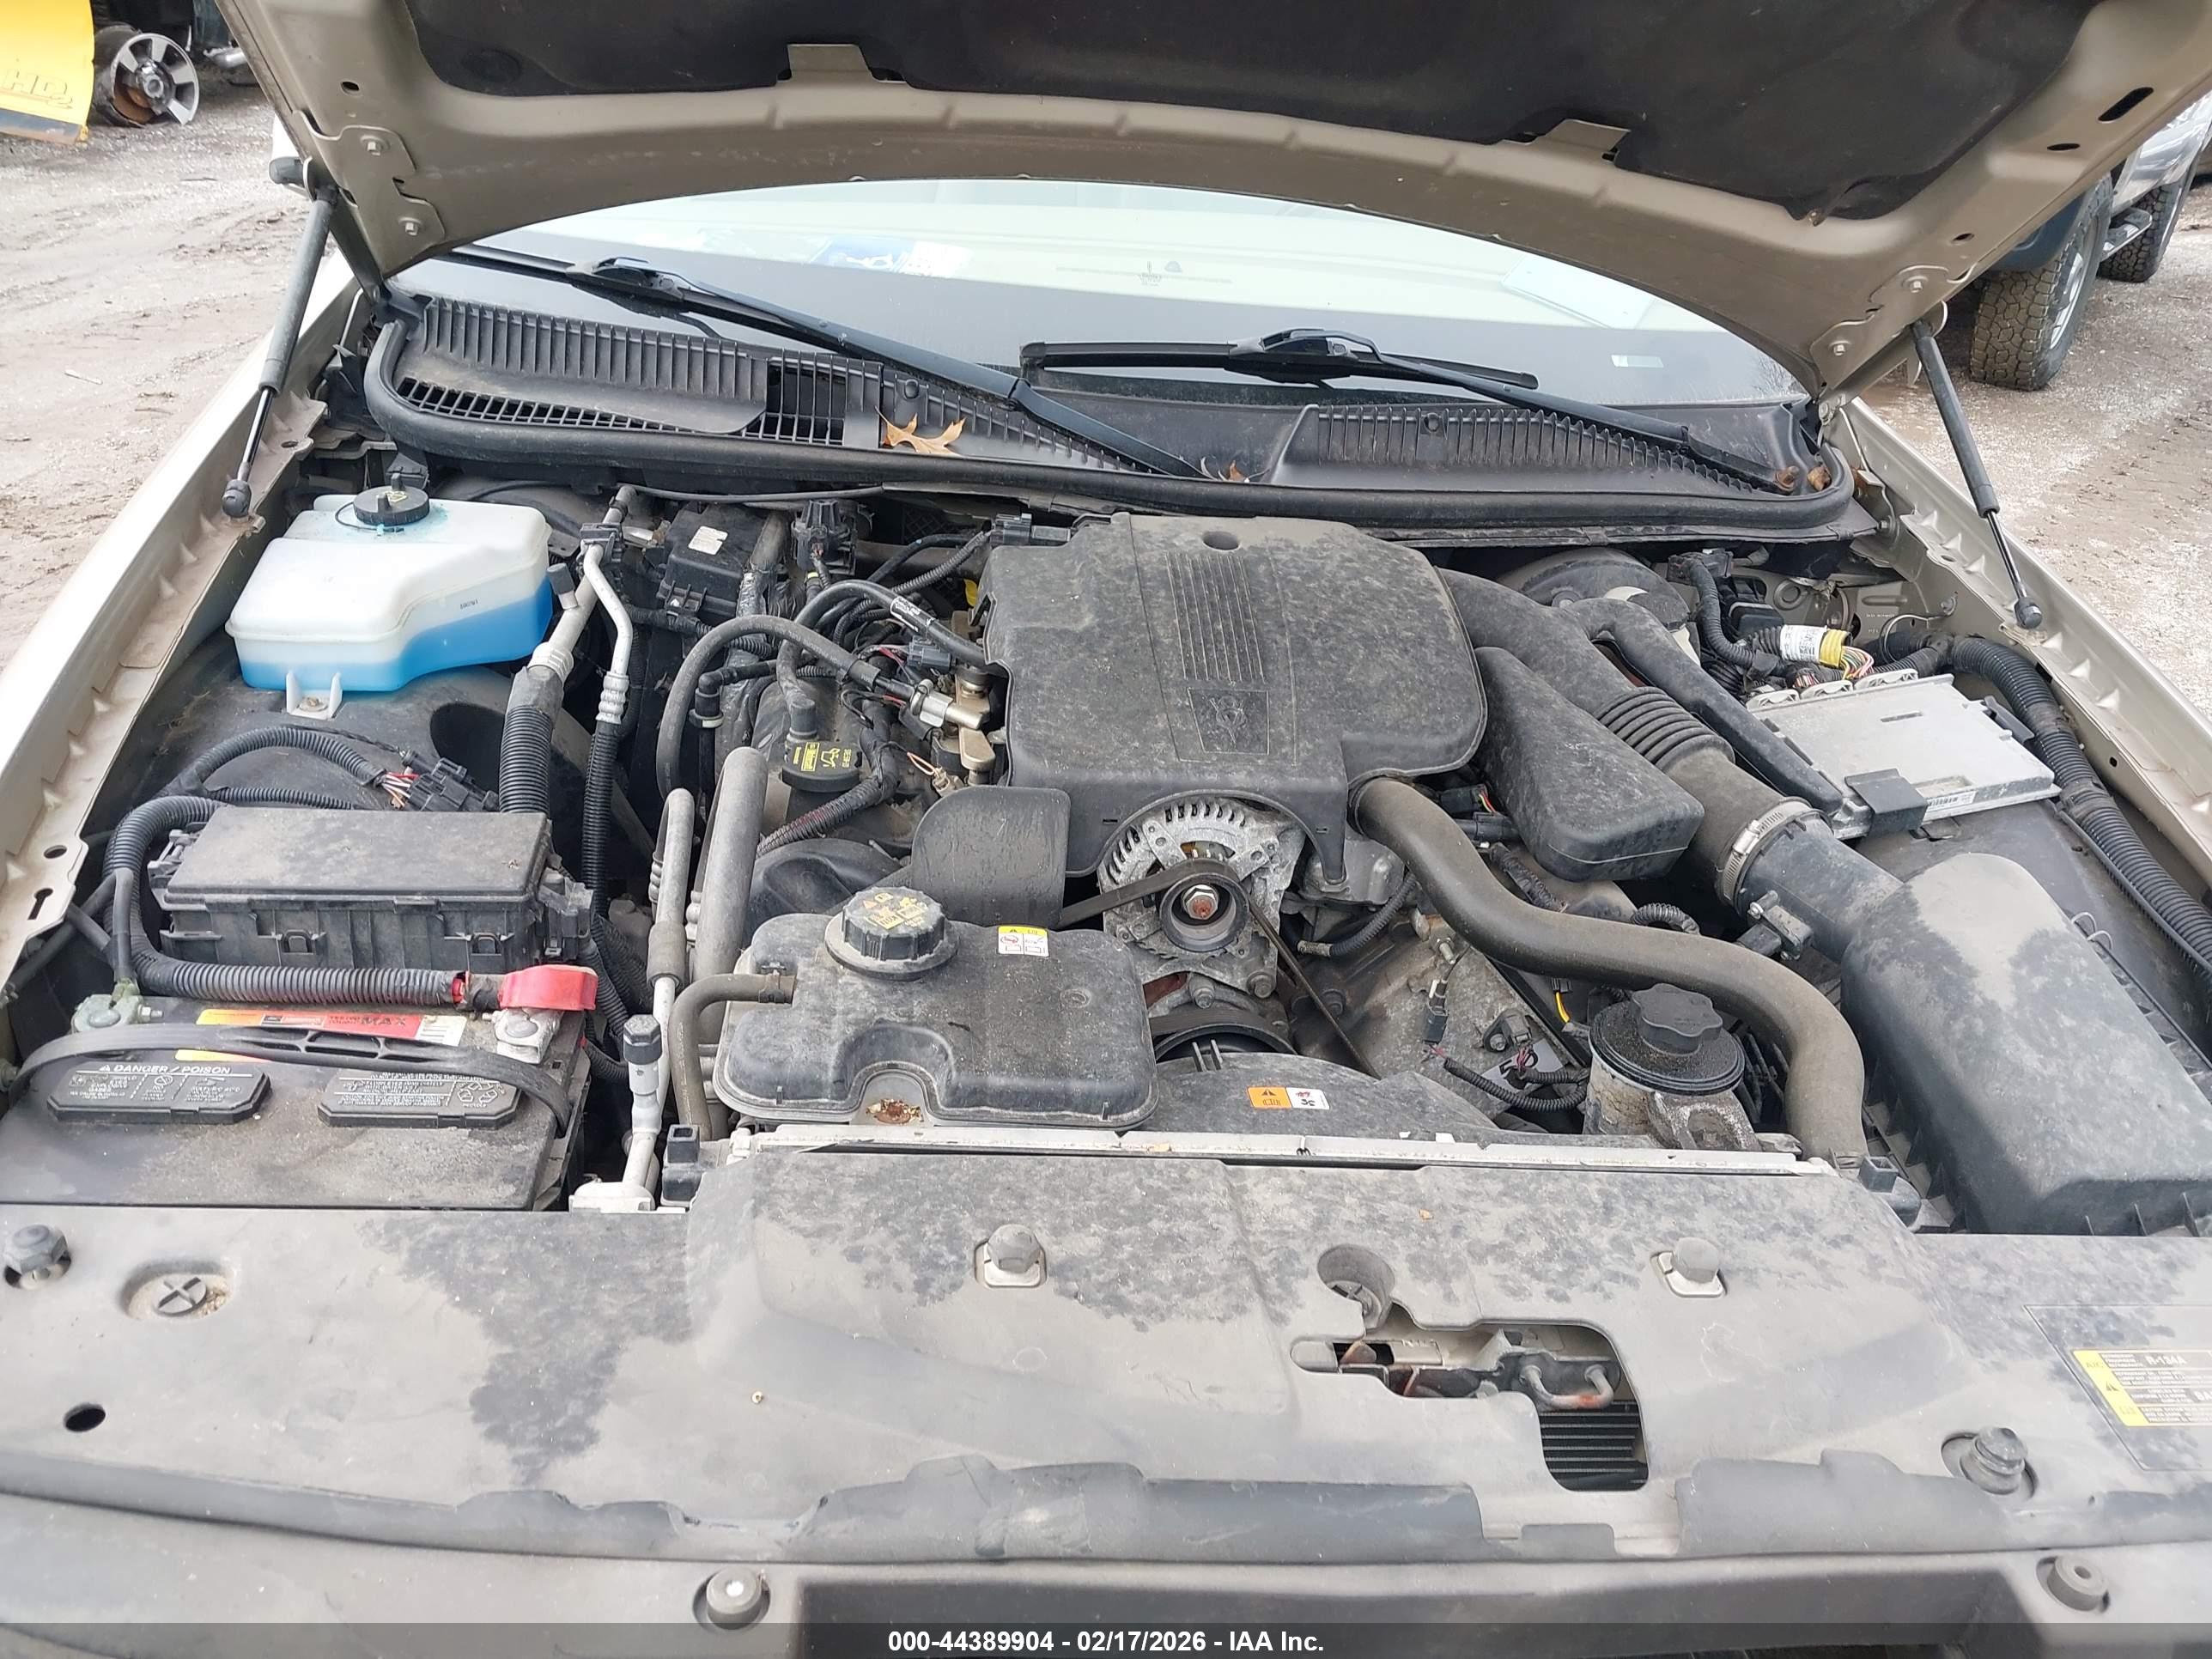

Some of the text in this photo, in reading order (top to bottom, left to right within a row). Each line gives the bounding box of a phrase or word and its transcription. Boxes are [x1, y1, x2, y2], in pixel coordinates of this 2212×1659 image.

[113, 1064, 172, 1073] DANGER
[183, 1066, 231, 1074] POISON
[2145, 1354, 2188, 1366] R-134A
